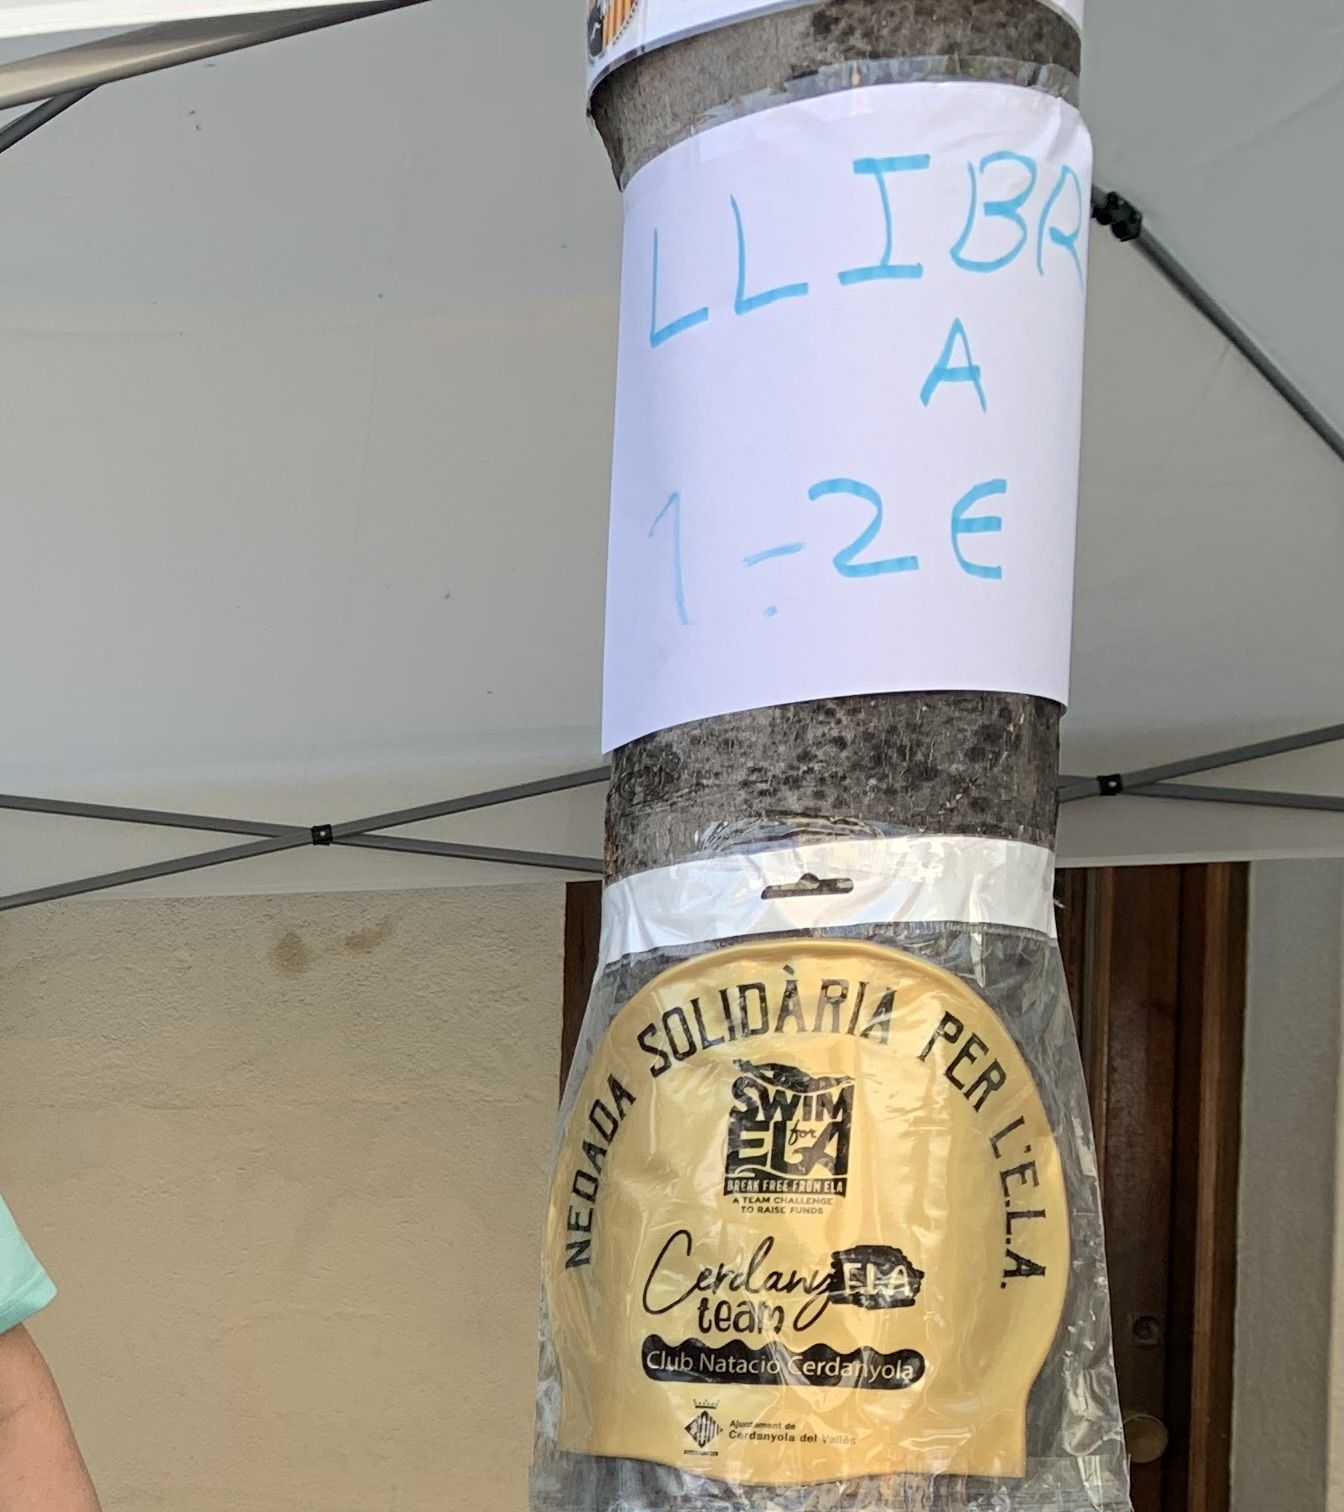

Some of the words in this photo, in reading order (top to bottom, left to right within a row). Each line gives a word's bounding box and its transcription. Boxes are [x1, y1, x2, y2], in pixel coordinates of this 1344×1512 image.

[920, 317, 987, 412] A
[729, 1074, 855, 1122] SWIM
[564, 1073, 638, 1271] NEDADA
[638, 966, 901, 1079] SOLIDÀRIA
[918, 1011, 1008, 1112] PER
[726, 1179, 760, 1193] BREAK
[762, 1179, 789, 1193] FREE
[792, 1180, 822, 1193] FROM
[823, 1180, 843, 1194] ELA
[742, 1197, 771, 1205] TEAM
[773, 1197, 833, 1206] CHALLENGE
[740, 1206, 755, 1214] TO
[757, 1206, 786, 1214] RAISE
[789, 1207, 824, 1215] FUNDS
[697, 1297, 785, 1335] team
[646, 1350, 694, 1372] Club
[787, 1355, 914, 1384] Cerdanyola
[728, 1431, 796, 1444] Cerdanyola
[799, 1434, 818, 1444] del
